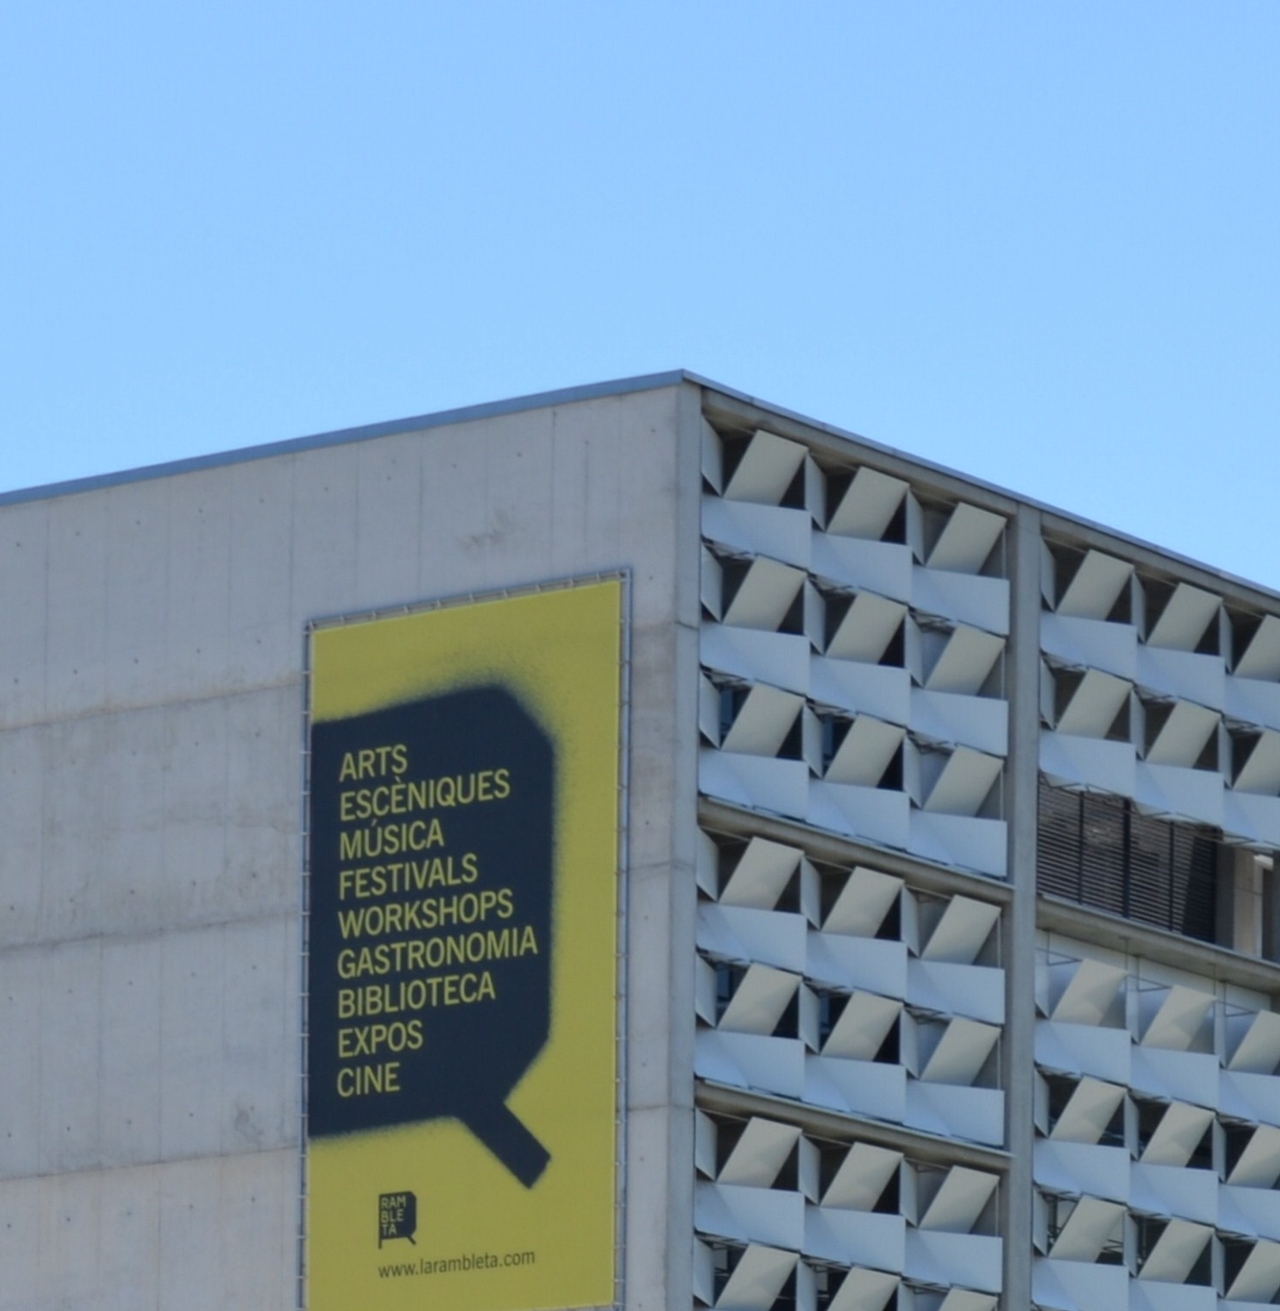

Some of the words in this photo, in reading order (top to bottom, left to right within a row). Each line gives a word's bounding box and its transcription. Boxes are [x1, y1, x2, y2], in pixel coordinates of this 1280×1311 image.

[339, 744, 408, 782] ARTS
[340, 768, 511, 821] ESCÈNIQUES
[340, 818, 445, 860] MÚSICA
[339, 853, 478, 900] FESTIVALS
[338, 888, 514, 939] WORKSHOPS
[337, 925, 538, 979] GASTRONOMIA
[338, 971, 496, 1019] BIBLIOTECA
[338, 1019, 423, 1058] EXPOS
[337, 1062, 401, 1097] CINE
[380, 1195, 407, 1210] RAM
[380, 1208, 404, 1224] BLE
[381, 1223, 397, 1237] TA
[378, 1251, 536, 1279] www.larambleta.com
